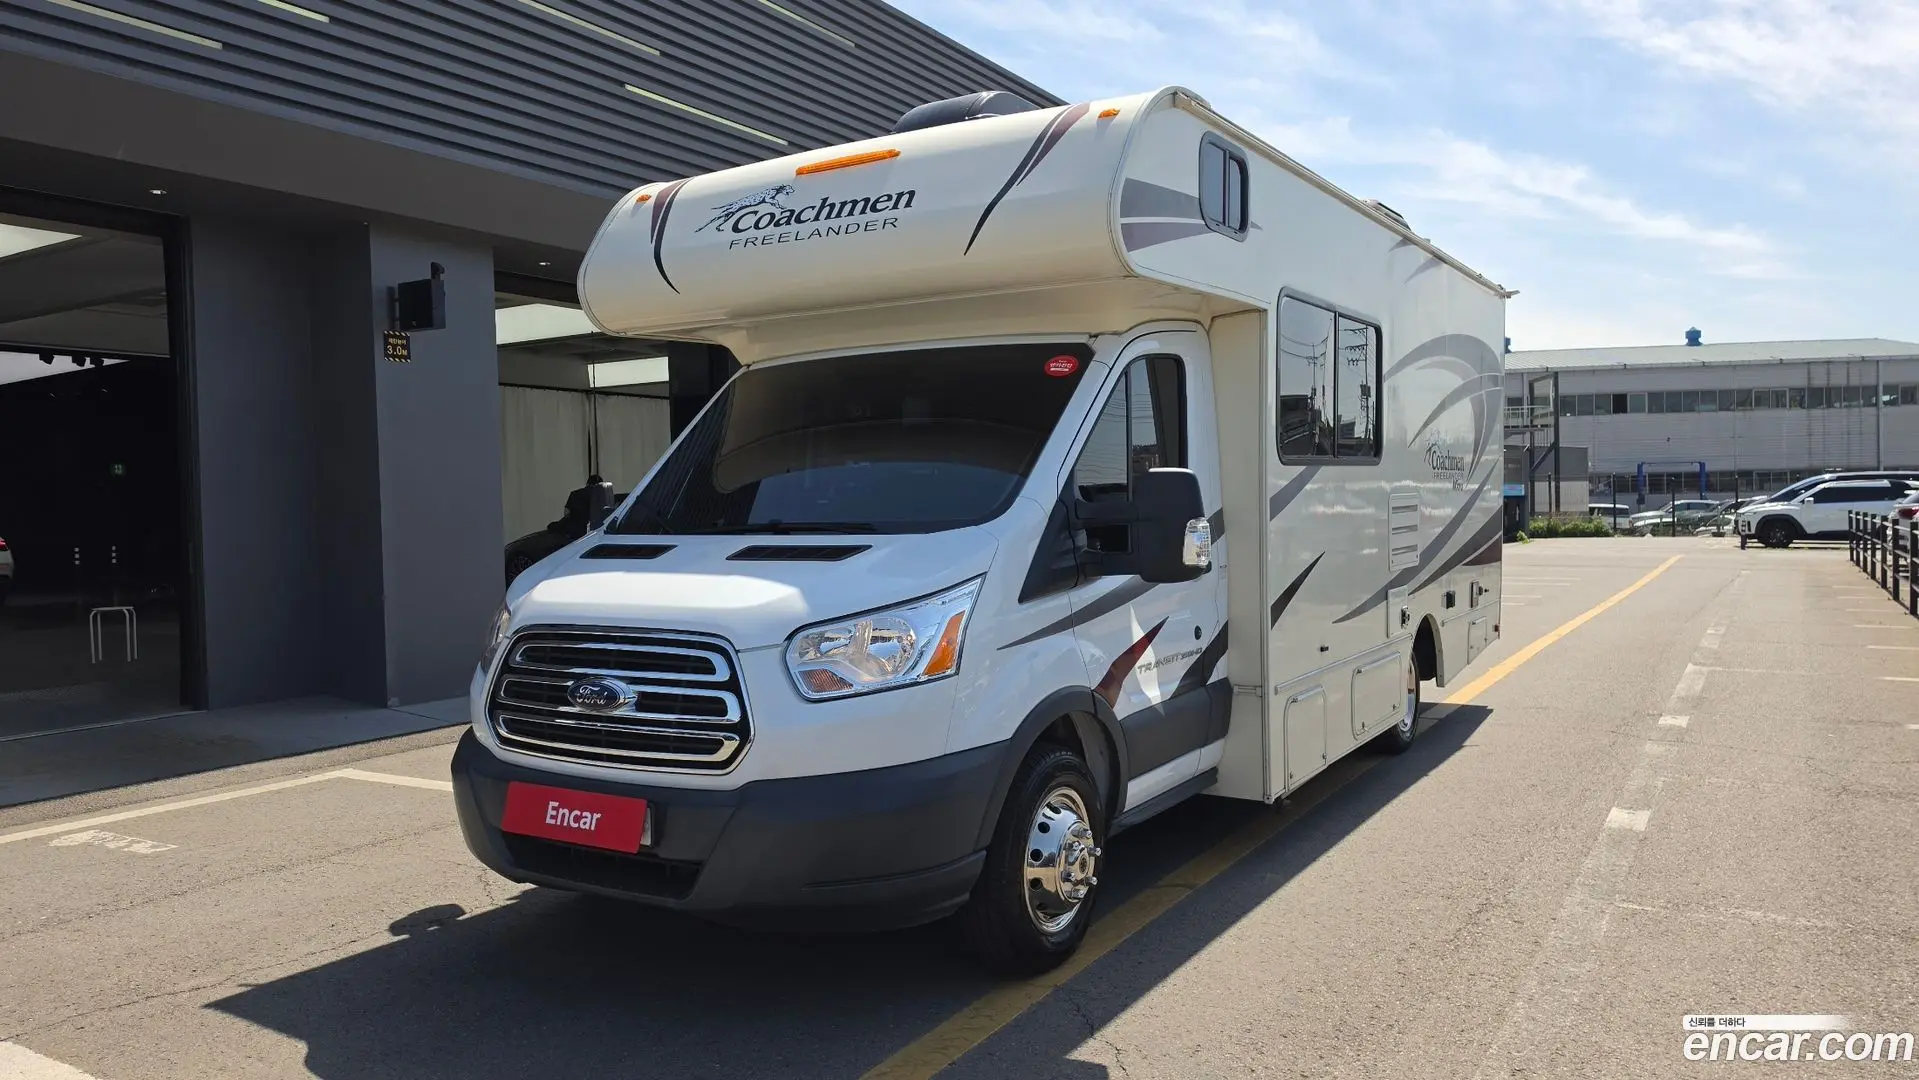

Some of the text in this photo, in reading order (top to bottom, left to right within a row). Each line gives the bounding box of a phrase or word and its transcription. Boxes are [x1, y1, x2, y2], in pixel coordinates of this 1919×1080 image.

[731, 189, 916, 234] Coachmen
[729, 217, 899, 250] FREELANDER
[1431, 450, 1465, 471] Coachmen
[1137, 653, 1179, 675] TRANSIT
[576, 685, 608, 705] Ford
[545, 801, 602, 831] Encar
